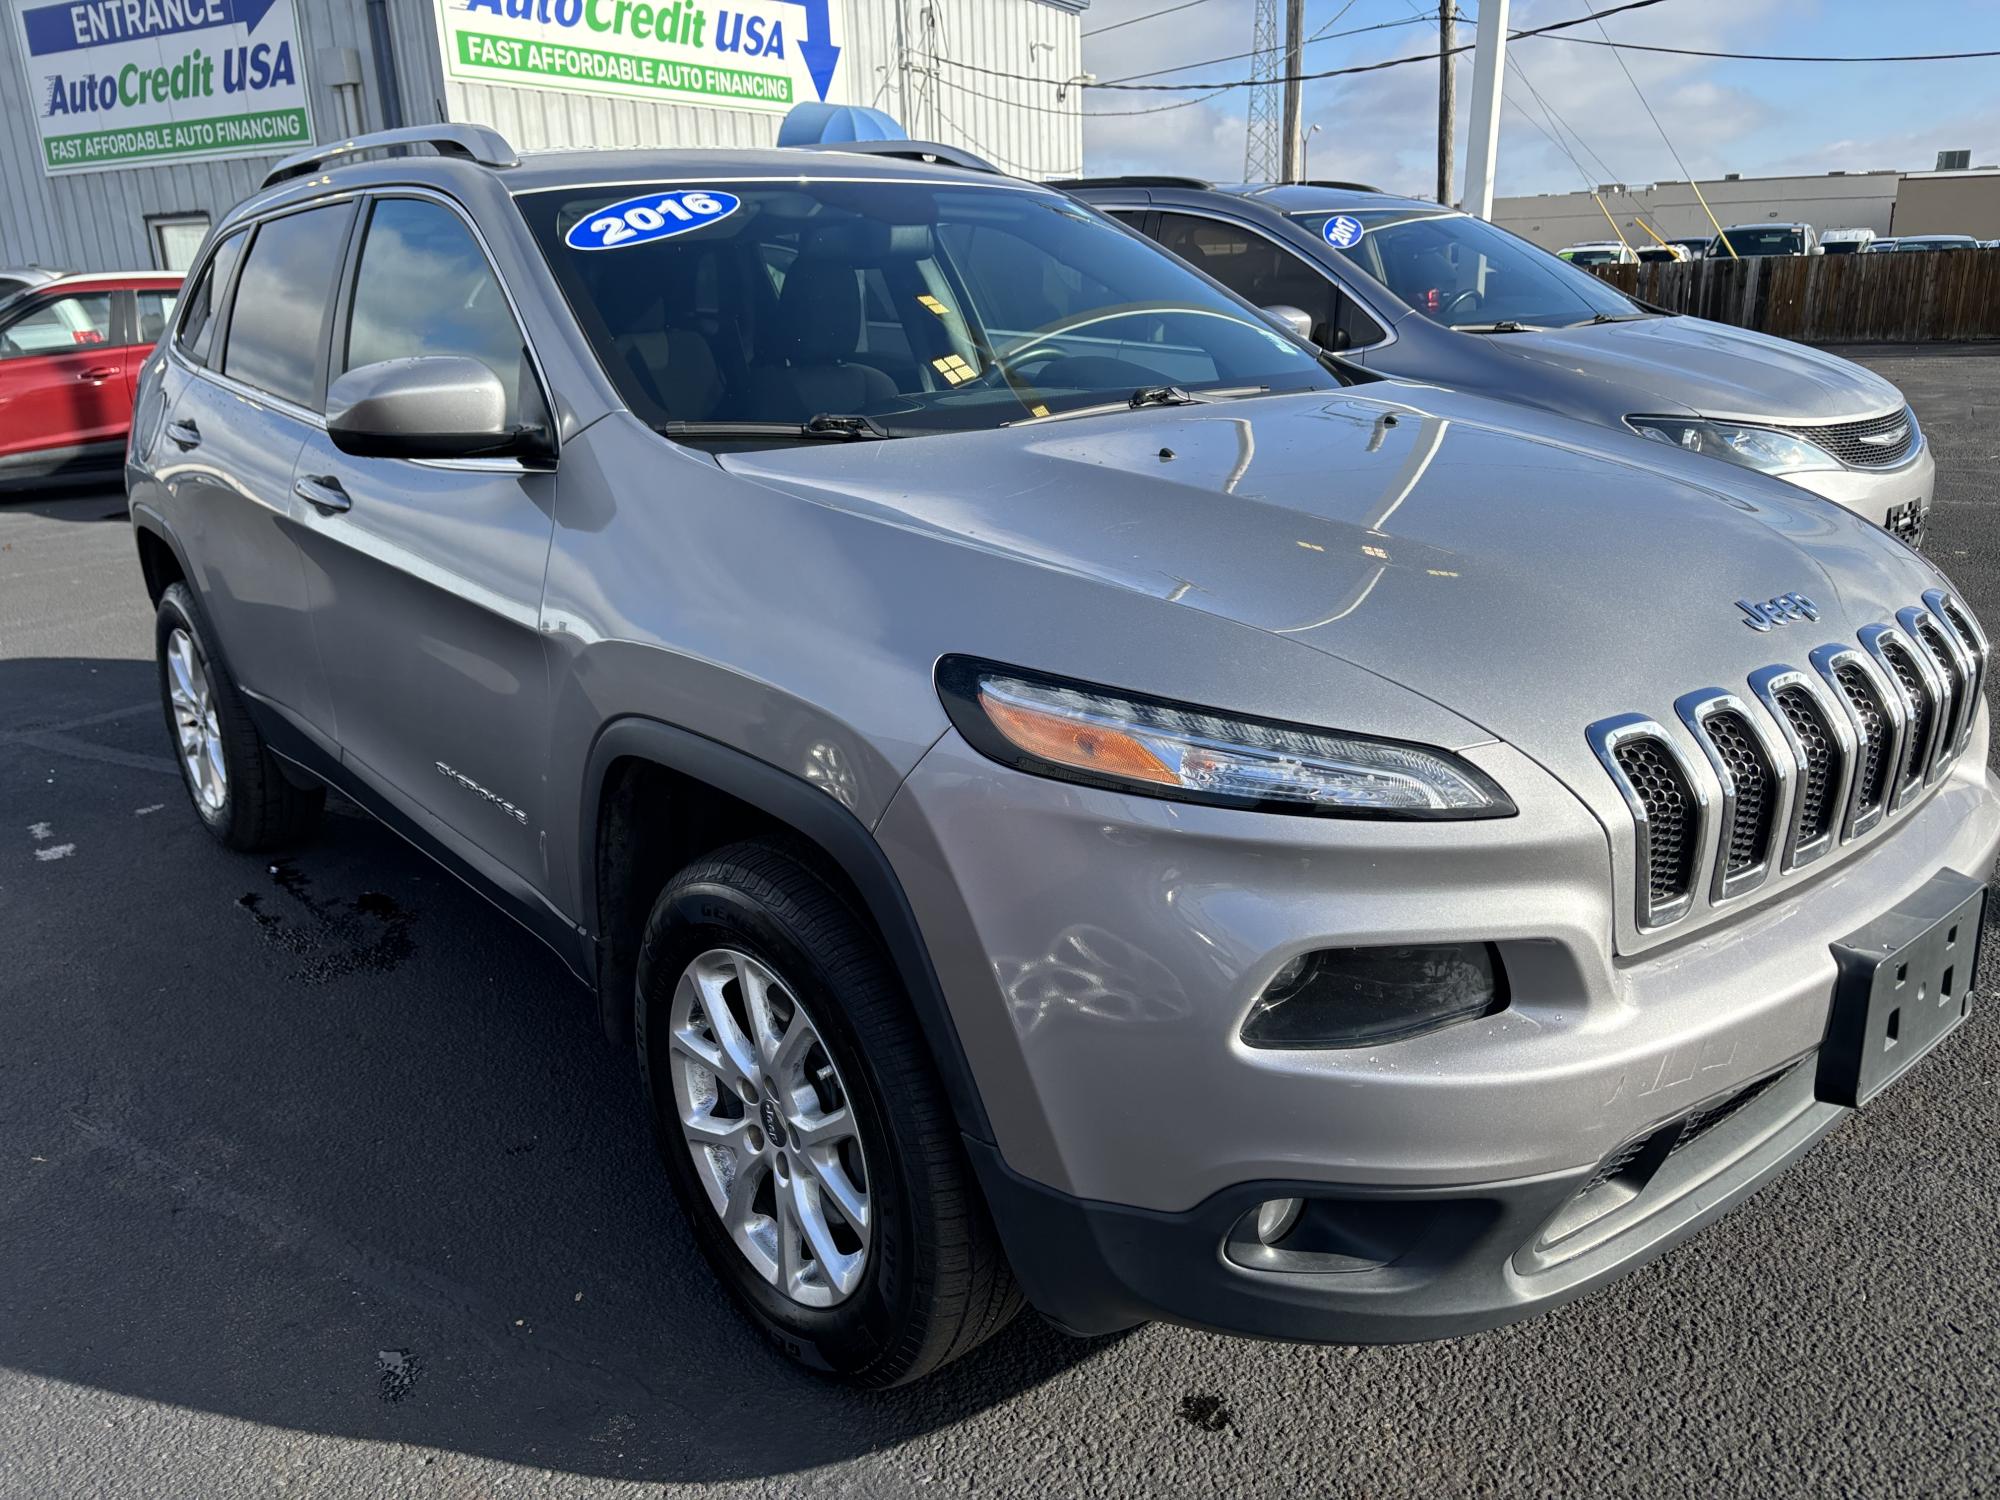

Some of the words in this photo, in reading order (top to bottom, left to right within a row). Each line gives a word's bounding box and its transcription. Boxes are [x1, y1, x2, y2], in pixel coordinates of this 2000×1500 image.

[70, 0, 225, 44] ENTRANCE
[715, 10, 785, 60] USA
[50, 49, 214, 116] AutoCredit
[223, 40, 296, 94] USA
[467, 36, 523, 67] FAST
[527, 45, 654, 83] AFFORDABLE
[656, 63, 703, 90] AUTO
[705, 70, 788, 100] FINANCING
[50, 139, 82, 160] FAST
[85, 128, 173, 157] AFFORDABLE
[175, 124, 214, 147] AUTO
[215, 114, 300, 143] FINANCING
[590, 193, 723, 245] 2016
[1329, 217, 1357, 246] 2017
[1733, 591, 1821, 633] Jeep
